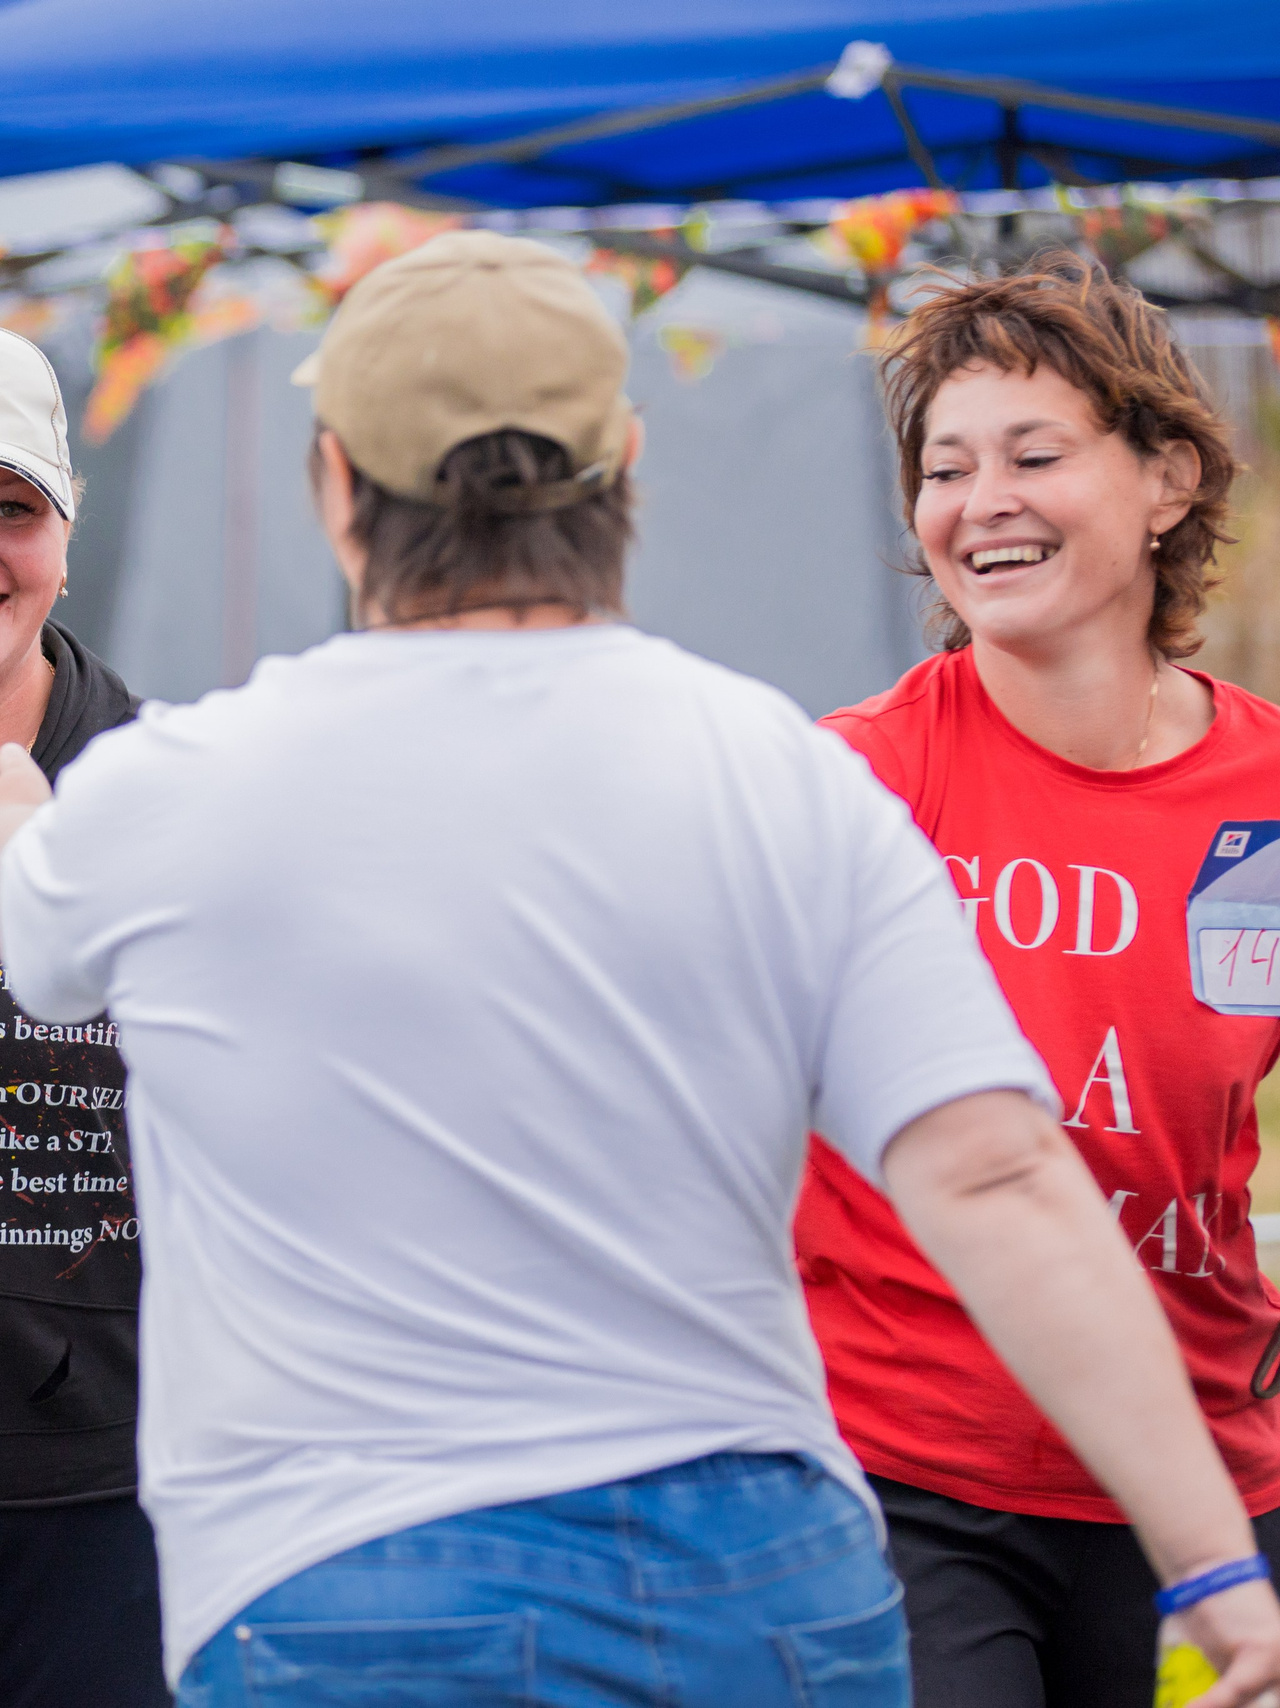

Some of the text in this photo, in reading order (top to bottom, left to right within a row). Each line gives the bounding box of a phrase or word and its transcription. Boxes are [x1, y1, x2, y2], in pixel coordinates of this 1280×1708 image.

[1060, 1025, 1141, 1134] A
[46, 1134, 61, 1151] a
[11, 1167, 67, 1194] best
[72, 1170, 128, 1193] time
[97, 1217, 142, 1242] NO
